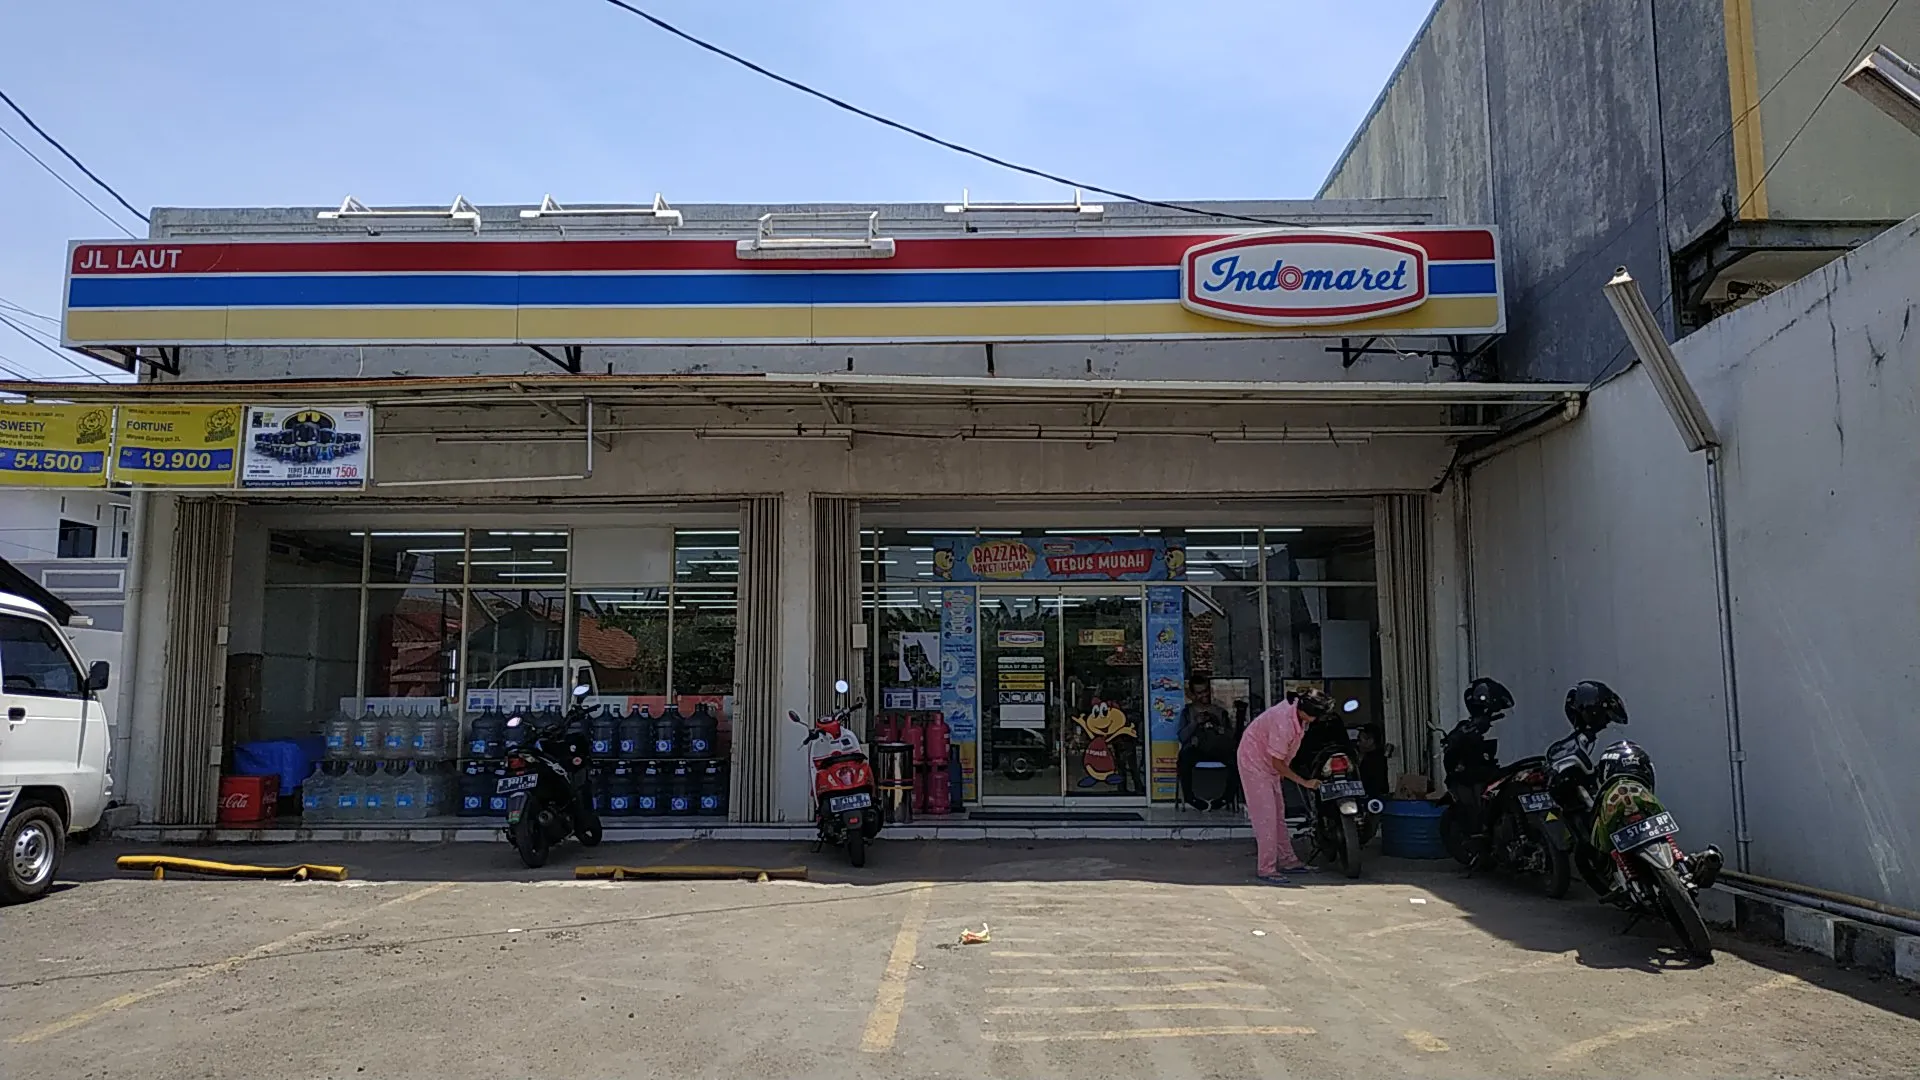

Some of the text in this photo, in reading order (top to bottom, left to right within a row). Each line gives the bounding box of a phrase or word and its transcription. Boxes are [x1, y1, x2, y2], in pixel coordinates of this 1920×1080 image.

[80, 249, 182, 269] JL LAUT
[1203, 255, 1408, 292] Indomaret
[0, 420, 45, 432] SWEETY
[126, 420, 174, 432] FORTUNE
[14, 452, 83, 471] 54.500
[141, 451, 211, 469] 19.900
[303, 466, 332, 475] BATMAN
[974, 545, 1029, 564] BAZZAR
[1053, 554, 1145, 572] TEBUS MURAH
[972, 560, 1032, 573] PAKET HEMAT
[226, 793, 250, 808] Cola
[1613, 815, 1668, 843] R 5743 RP
